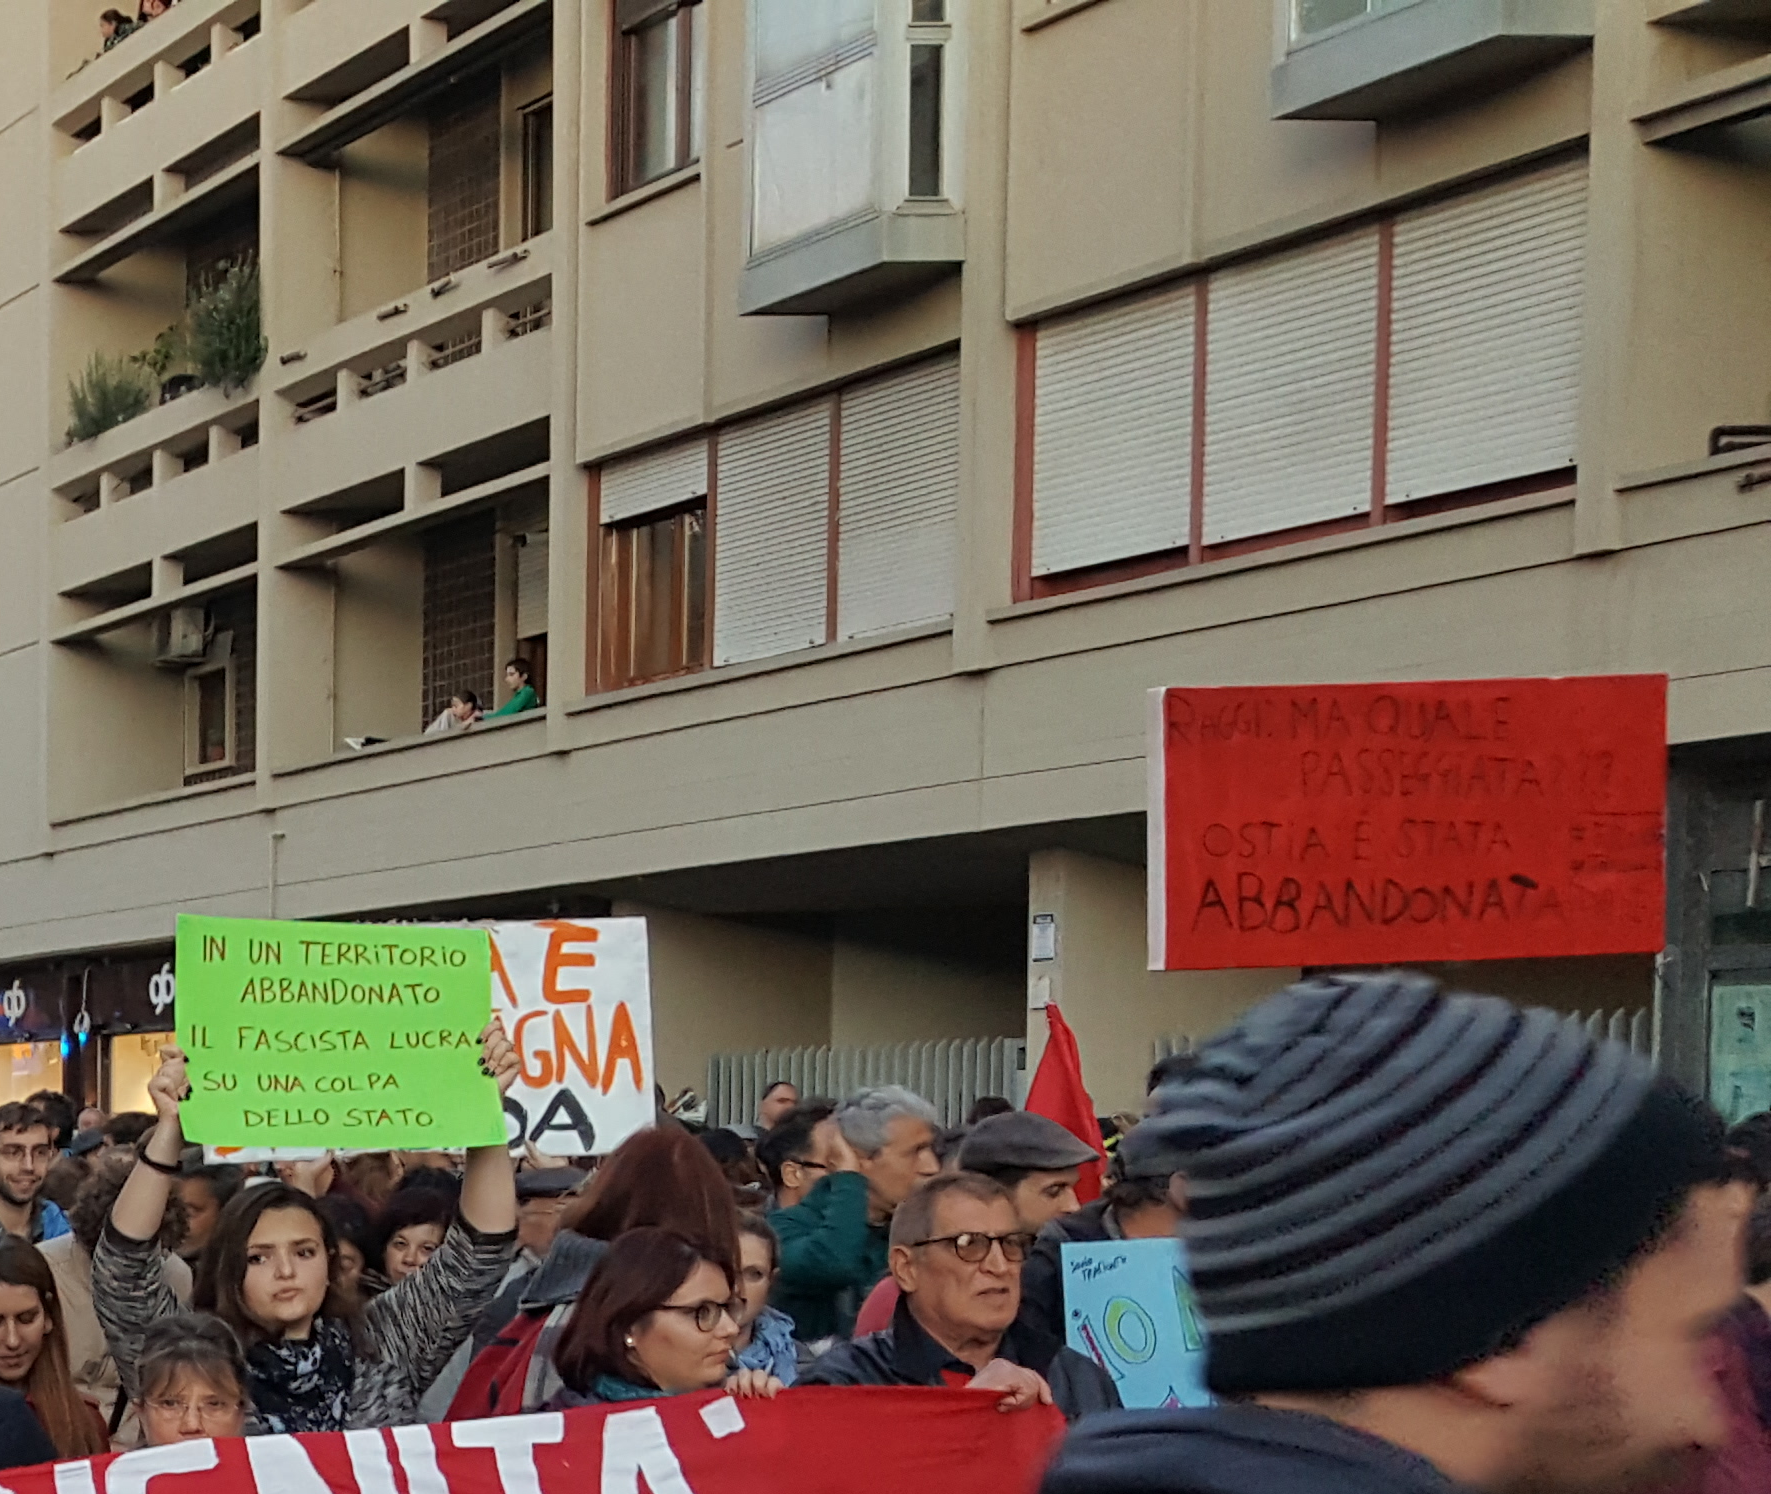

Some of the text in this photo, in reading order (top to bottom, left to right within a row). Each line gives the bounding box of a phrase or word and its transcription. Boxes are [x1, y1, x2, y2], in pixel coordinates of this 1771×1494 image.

[1289, 695, 1350, 741] MA
[1366, 693, 1512, 742] QUALE
[1396, 815, 1513, 858] STATA
[1191, 870, 1568, 933] ABBANDONATA
[202, 934, 227, 962] IN
[248, 937, 282, 965] UN
[240, 976, 442, 1006] ABBANDONATO
[191, 1024, 474, 1053] IL FASCISTA LUCRA
[202, 1070, 400, 1094] SU UNA COLPA
[242, 1107, 434, 1128] DELLO STATO
